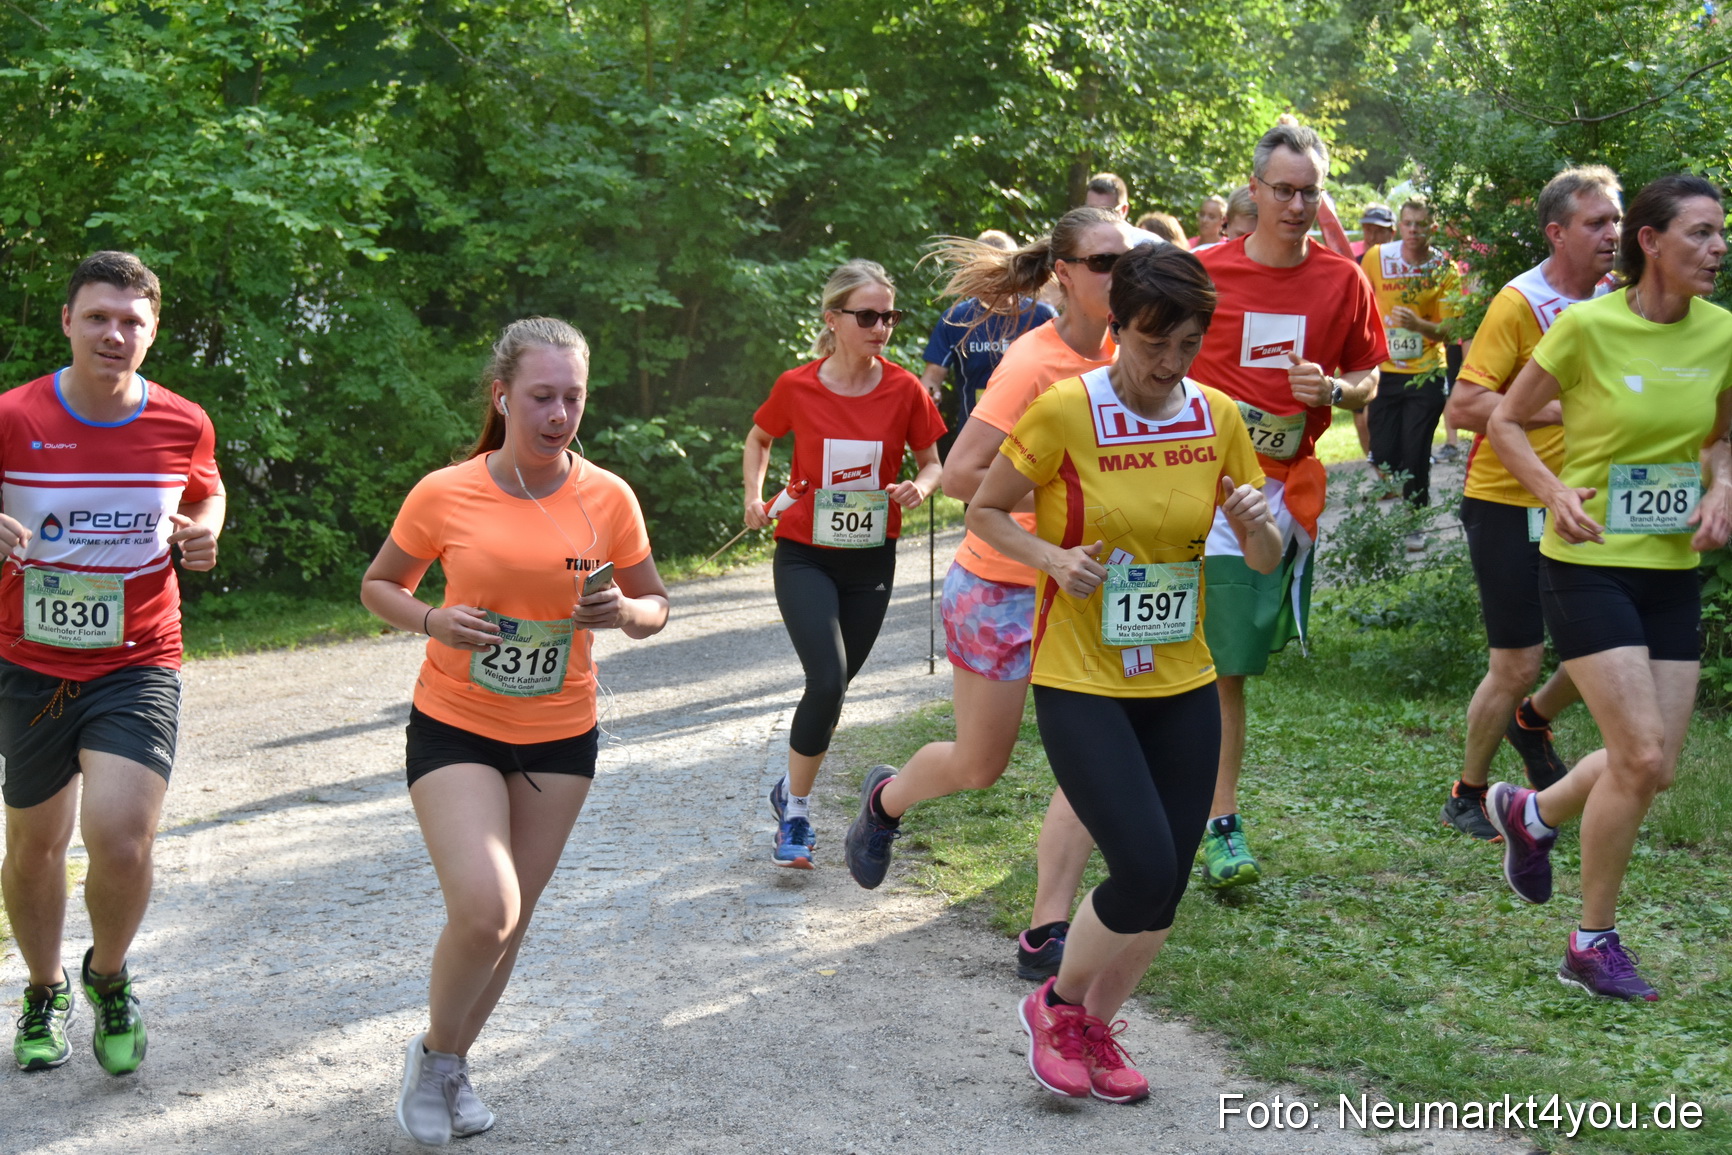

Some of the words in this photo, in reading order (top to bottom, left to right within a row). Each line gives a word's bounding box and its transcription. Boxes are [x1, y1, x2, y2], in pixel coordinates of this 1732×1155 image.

[1262, 345, 1282, 356] DEHN
[1098, 451, 1157, 472] MAX
[1164, 445, 1217, 467] BÖGL
[842, 469, 862, 480] DEHN
[1620, 489, 1688, 515] 1208
[69, 510, 163, 533] Petry
[831, 511, 873, 532] 504
[1630, 515, 1653, 523] Brandl
[68, 536, 101, 546] WÄRME
[35, 596, 110, 628] 1830
[1117, 591, 1187, 622] 1597
[38, 623, 77, 635] Maierhofer
[78, 628, 107, 636] Florian
[1116, 623, 1161, 633] Heydemann
[1162, 621, 1186, 629] Yvonne
[481, 643, 559, 675] 2318
[484, 668, 516, 683] Weigert
[517, 675, 552, 684] Katharina
[501, 682, 517, 690] Thule
